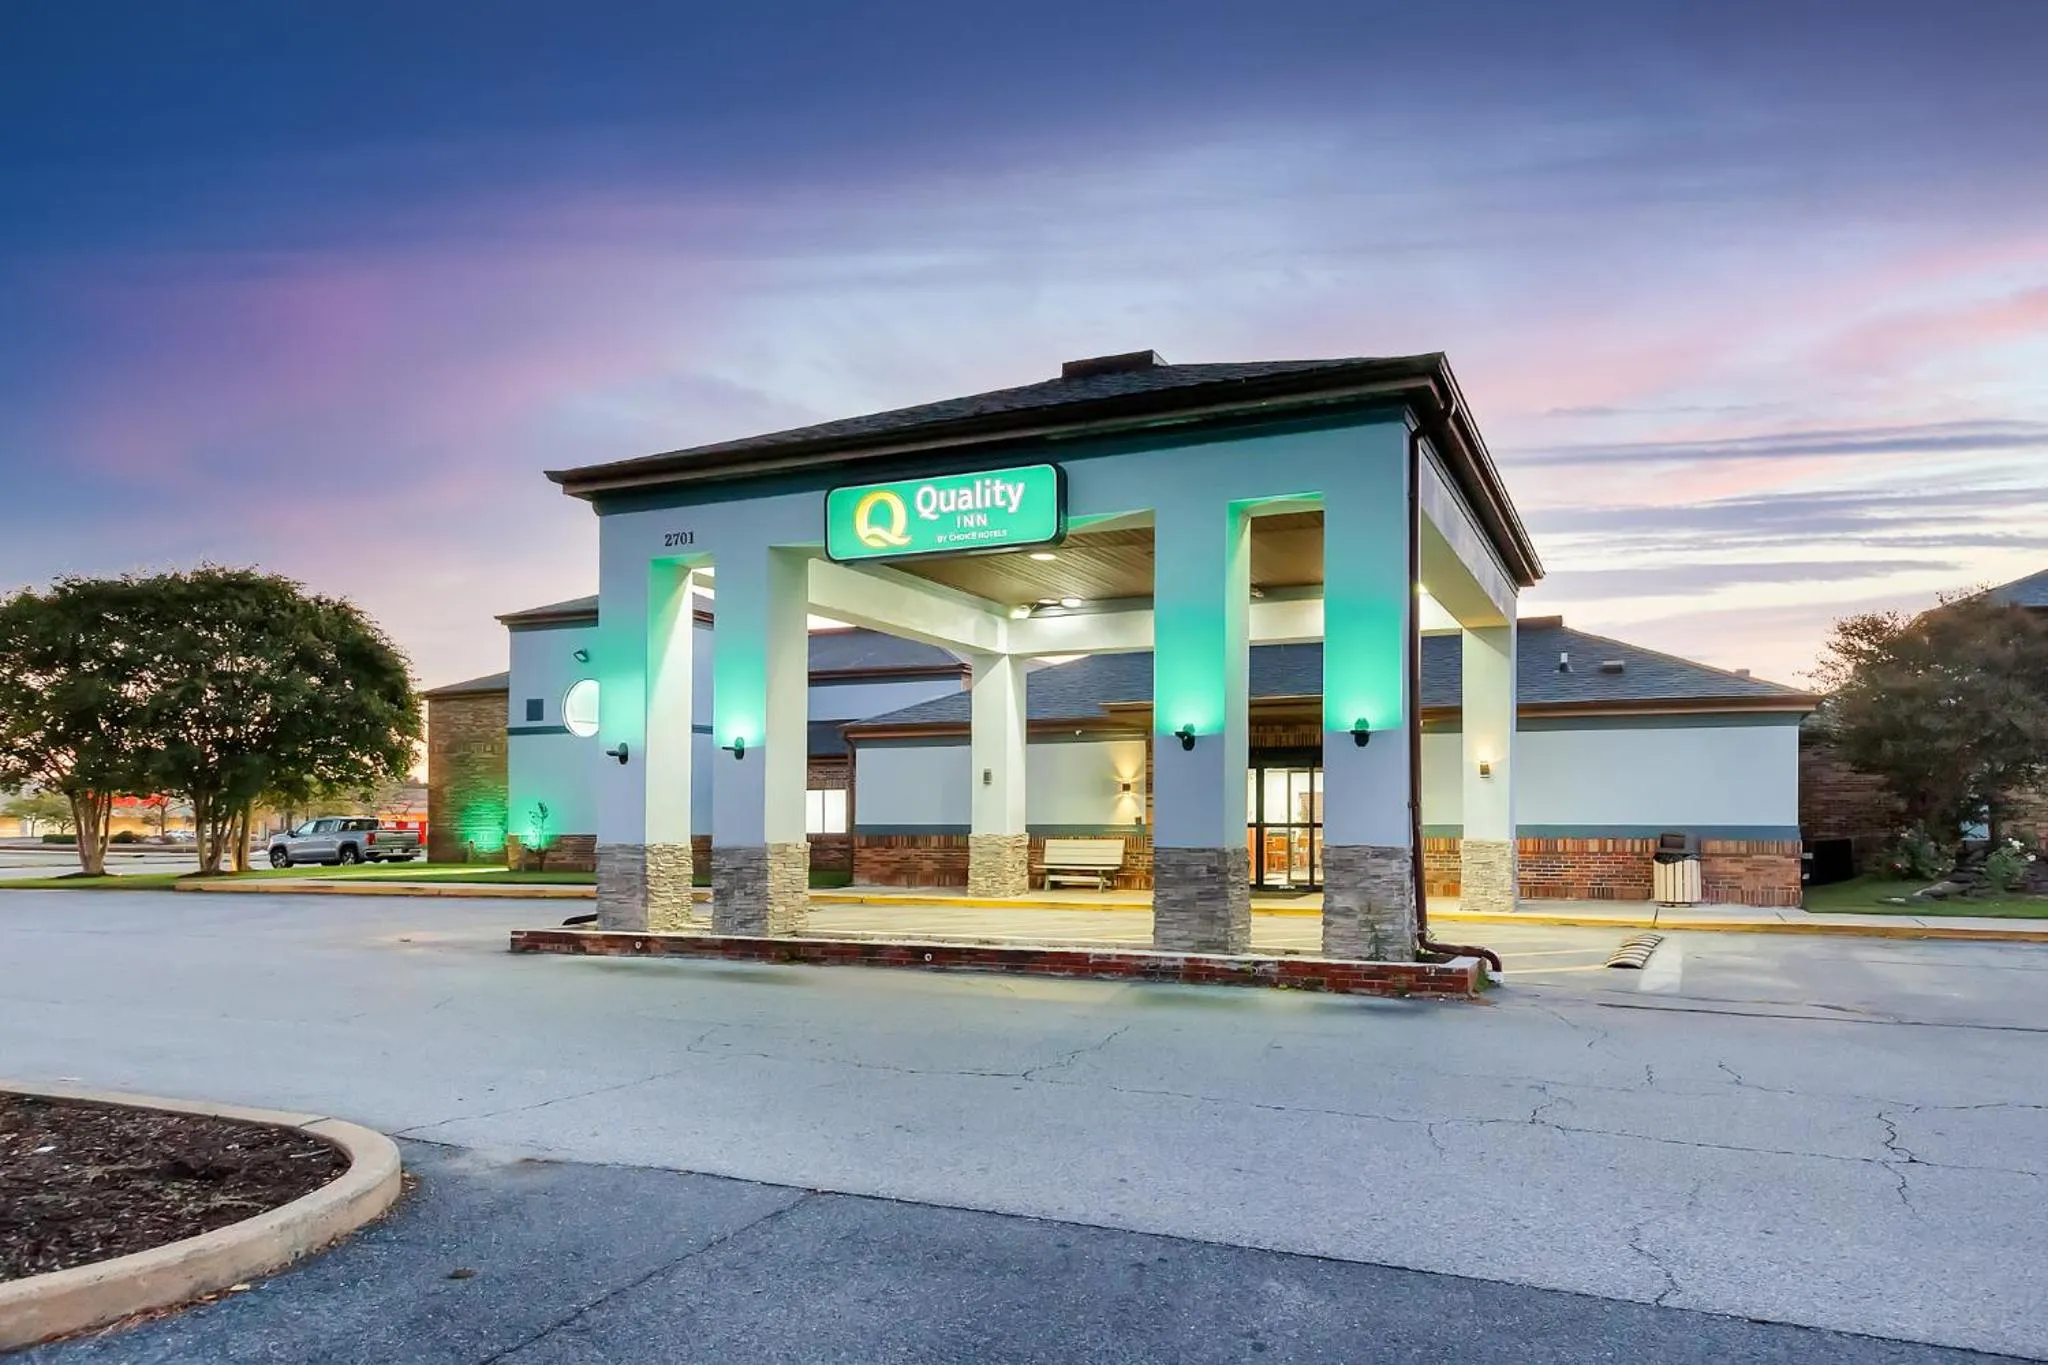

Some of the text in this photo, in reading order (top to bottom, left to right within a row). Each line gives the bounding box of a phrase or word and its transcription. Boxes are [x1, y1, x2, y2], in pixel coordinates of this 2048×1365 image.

[915, 478, 1025, 520] Quality
[956, 513, 988, 528] INN
[664, 531, 694, 547] 2701
